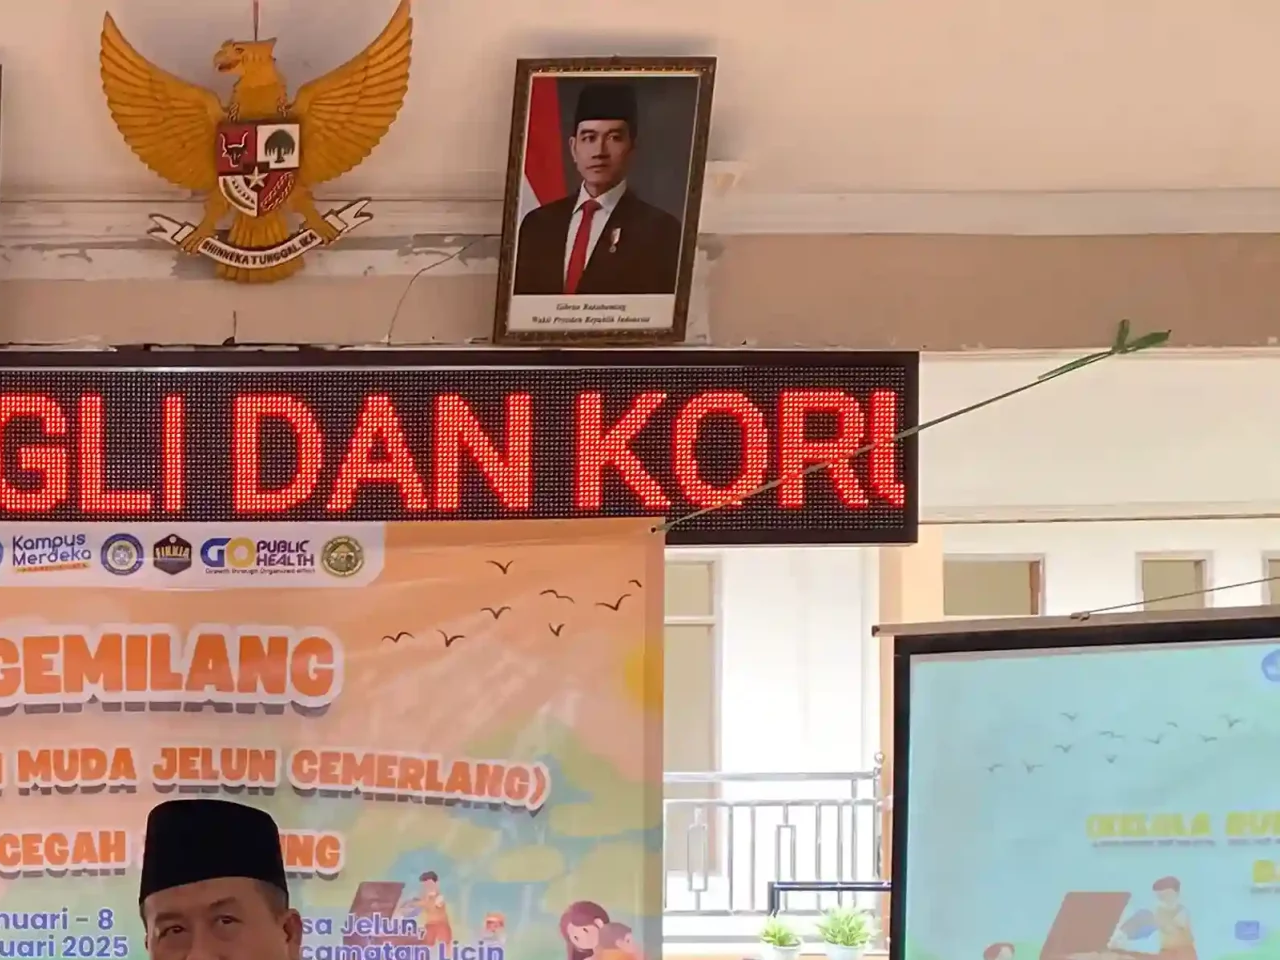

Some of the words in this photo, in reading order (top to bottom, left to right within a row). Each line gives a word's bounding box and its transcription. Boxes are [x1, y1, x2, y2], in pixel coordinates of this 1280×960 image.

[300, 234, 318, 251] IKA
[232, 392, 533, 513] DAN
[12, 534, 86, 551] Kampus
[256, 540, 310, 553] PUBLIC
[12, 548, 92, 566] Merdeka
[256, 553, 314, 566] HEALTH
[16, 747, 137, 785] MUDA
[152, 747, 276, 784] JELUN
[291, 749, 547, 806] CEMERLANG)
[97, 908, 114, 930] 8
[301, 917, 332, 933] sa
[341, 913, 426, 937] Jelun,
[61, 936, 129, 958] 2025
